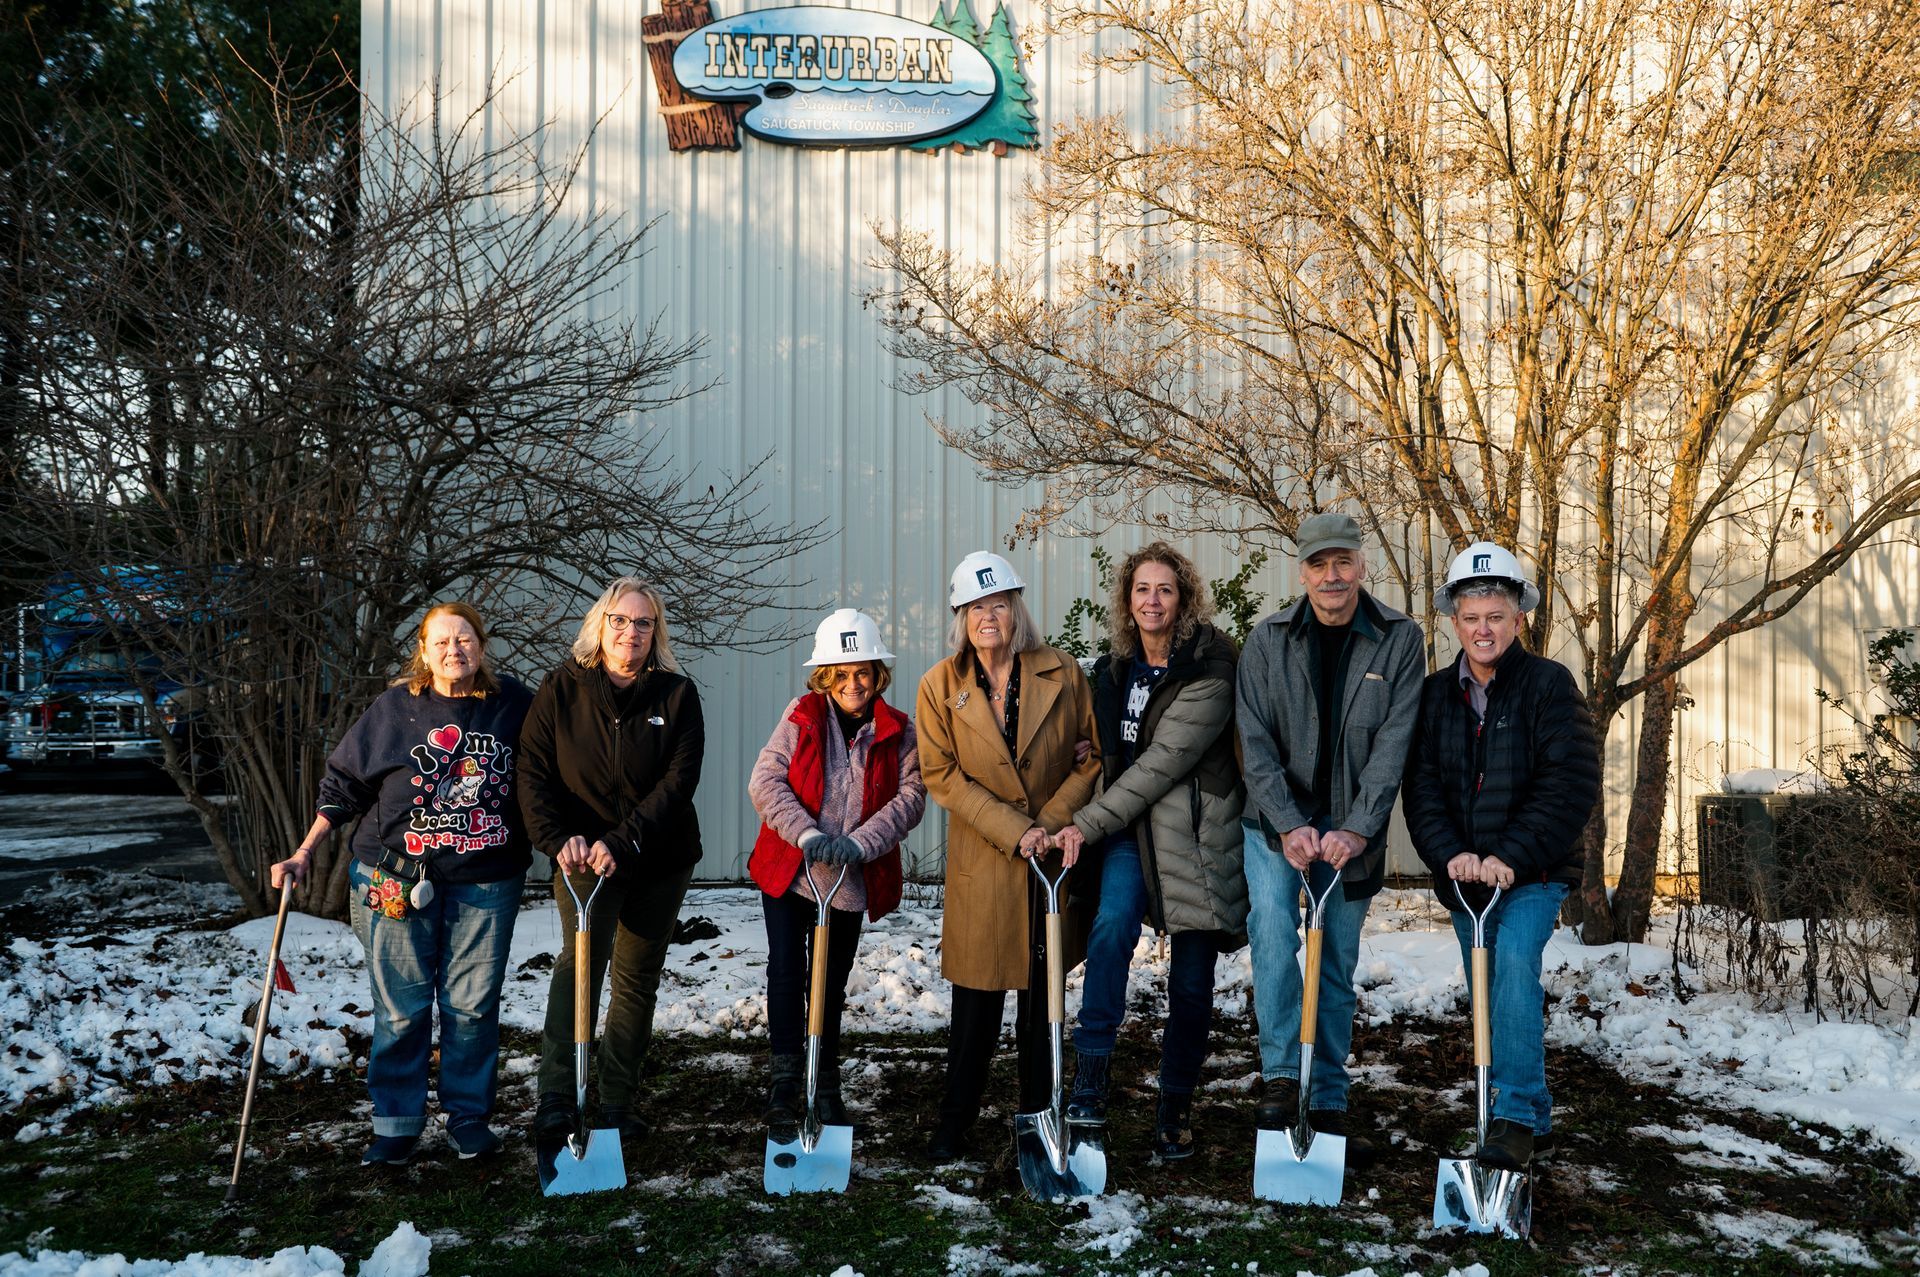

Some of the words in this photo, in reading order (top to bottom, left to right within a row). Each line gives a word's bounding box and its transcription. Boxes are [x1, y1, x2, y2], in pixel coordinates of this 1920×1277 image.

[704, 32, 953, 84] INTERURBAN
[794, 95, 875, 116] Saugatuck
[887, 98, 952, 120] Douglas
[761, 118, 841, 131] SAUGATUCK
[848, 118, 916, 133] TOWNSHIP
[410, 745, 438, 774] I
[410, 808, 466, 831] Local
[468, 808, 501, 834] Fire
[404, 826, 509, 855] Department
